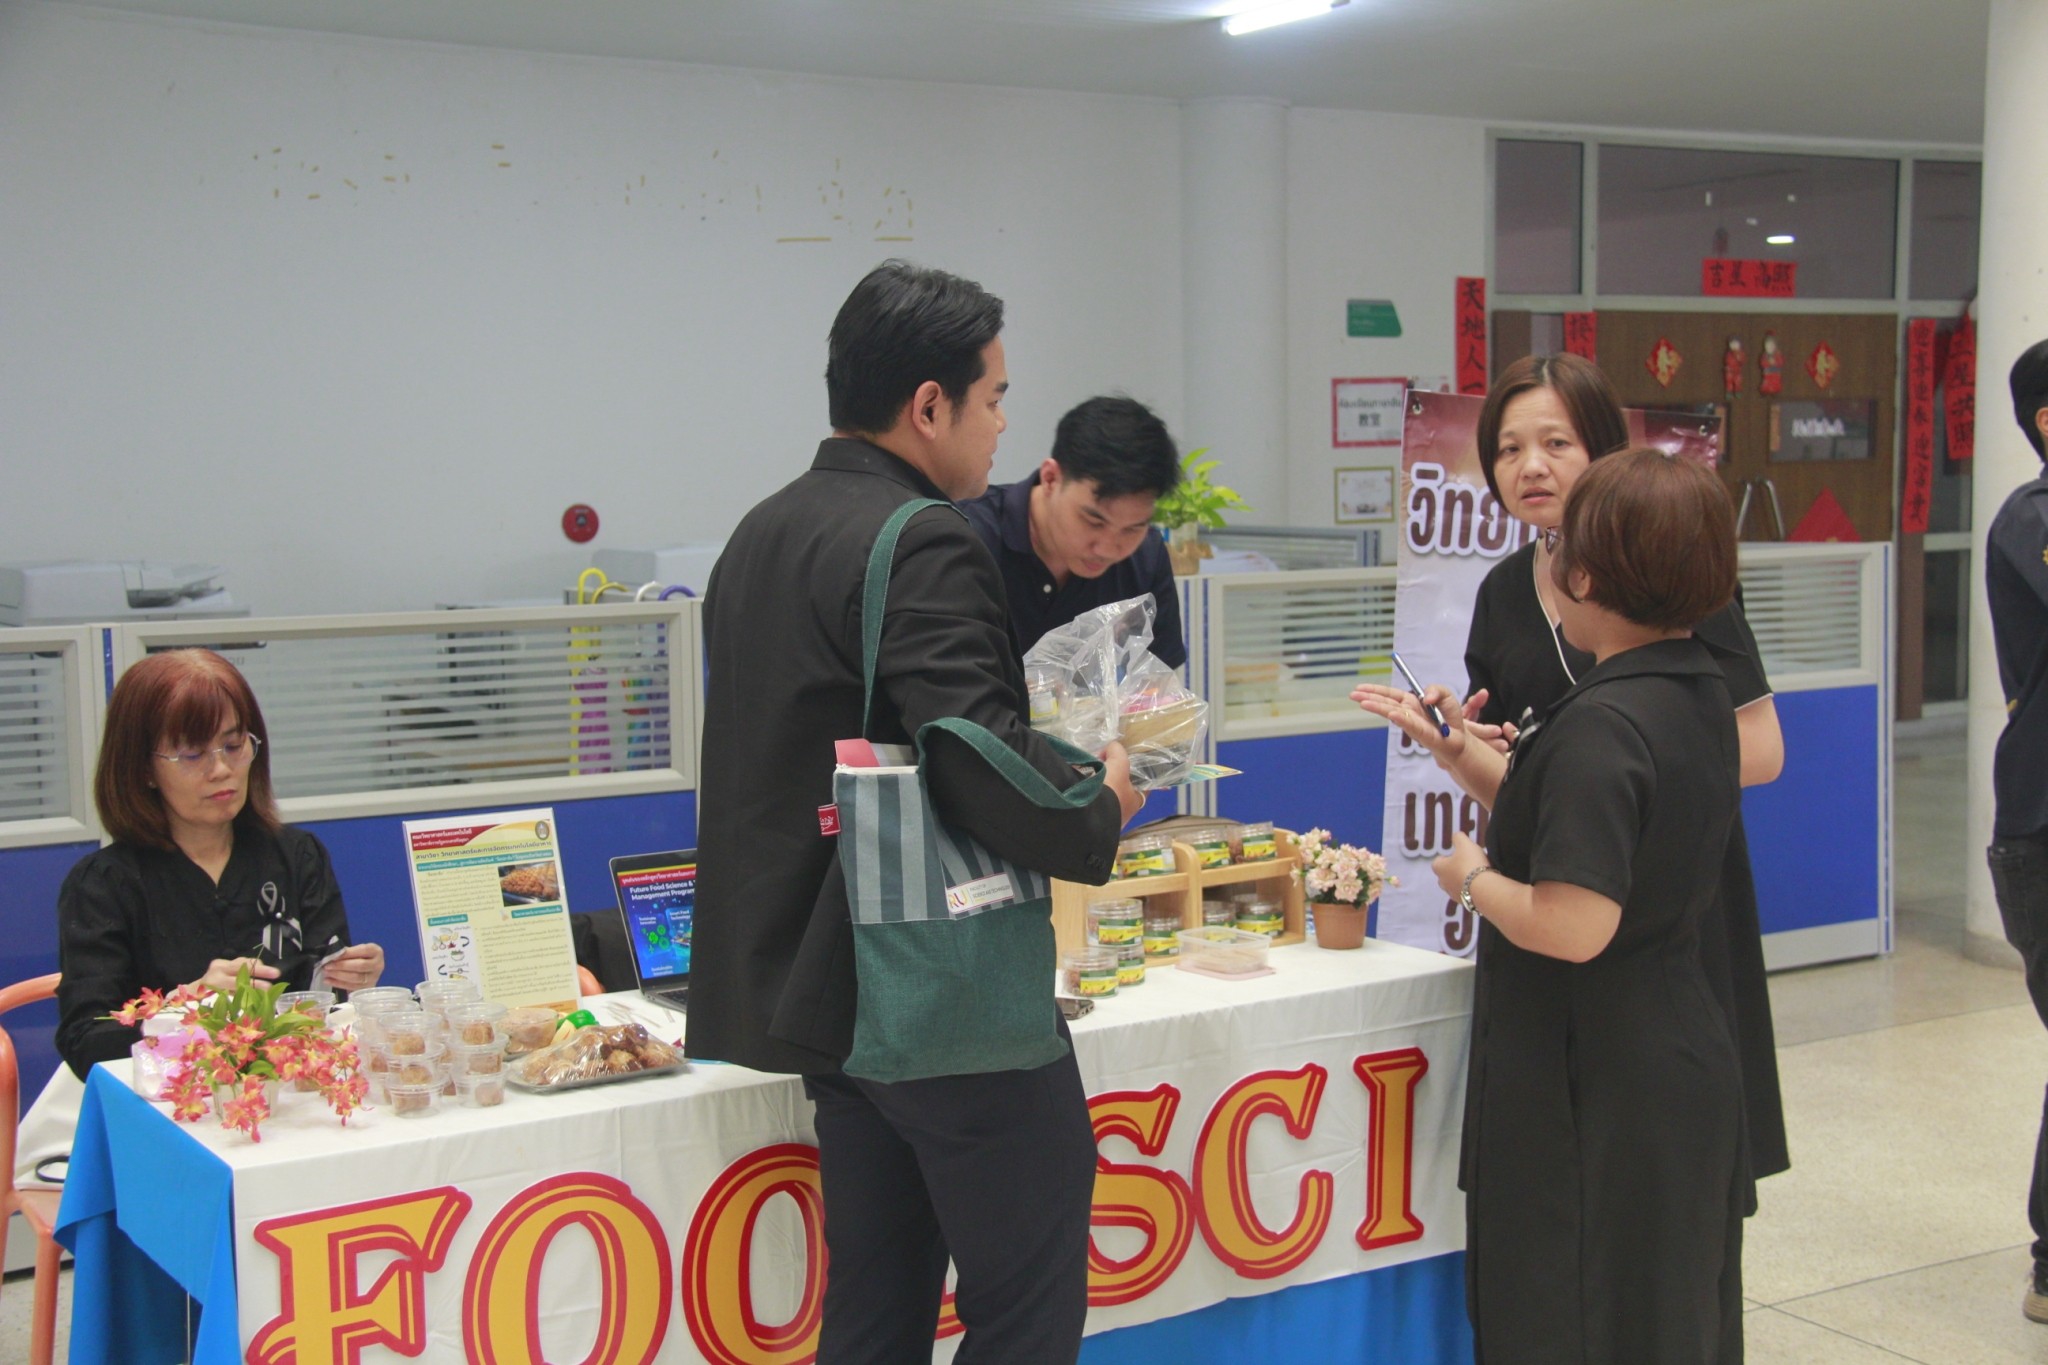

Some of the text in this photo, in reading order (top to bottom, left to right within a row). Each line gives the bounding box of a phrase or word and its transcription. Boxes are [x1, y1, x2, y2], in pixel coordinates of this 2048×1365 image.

[629, 886, 649, 894] Future
[649, 883, 665, 892] Food
[665, 881, 688, 890] Science
[631, 890, 671, 901] Management
